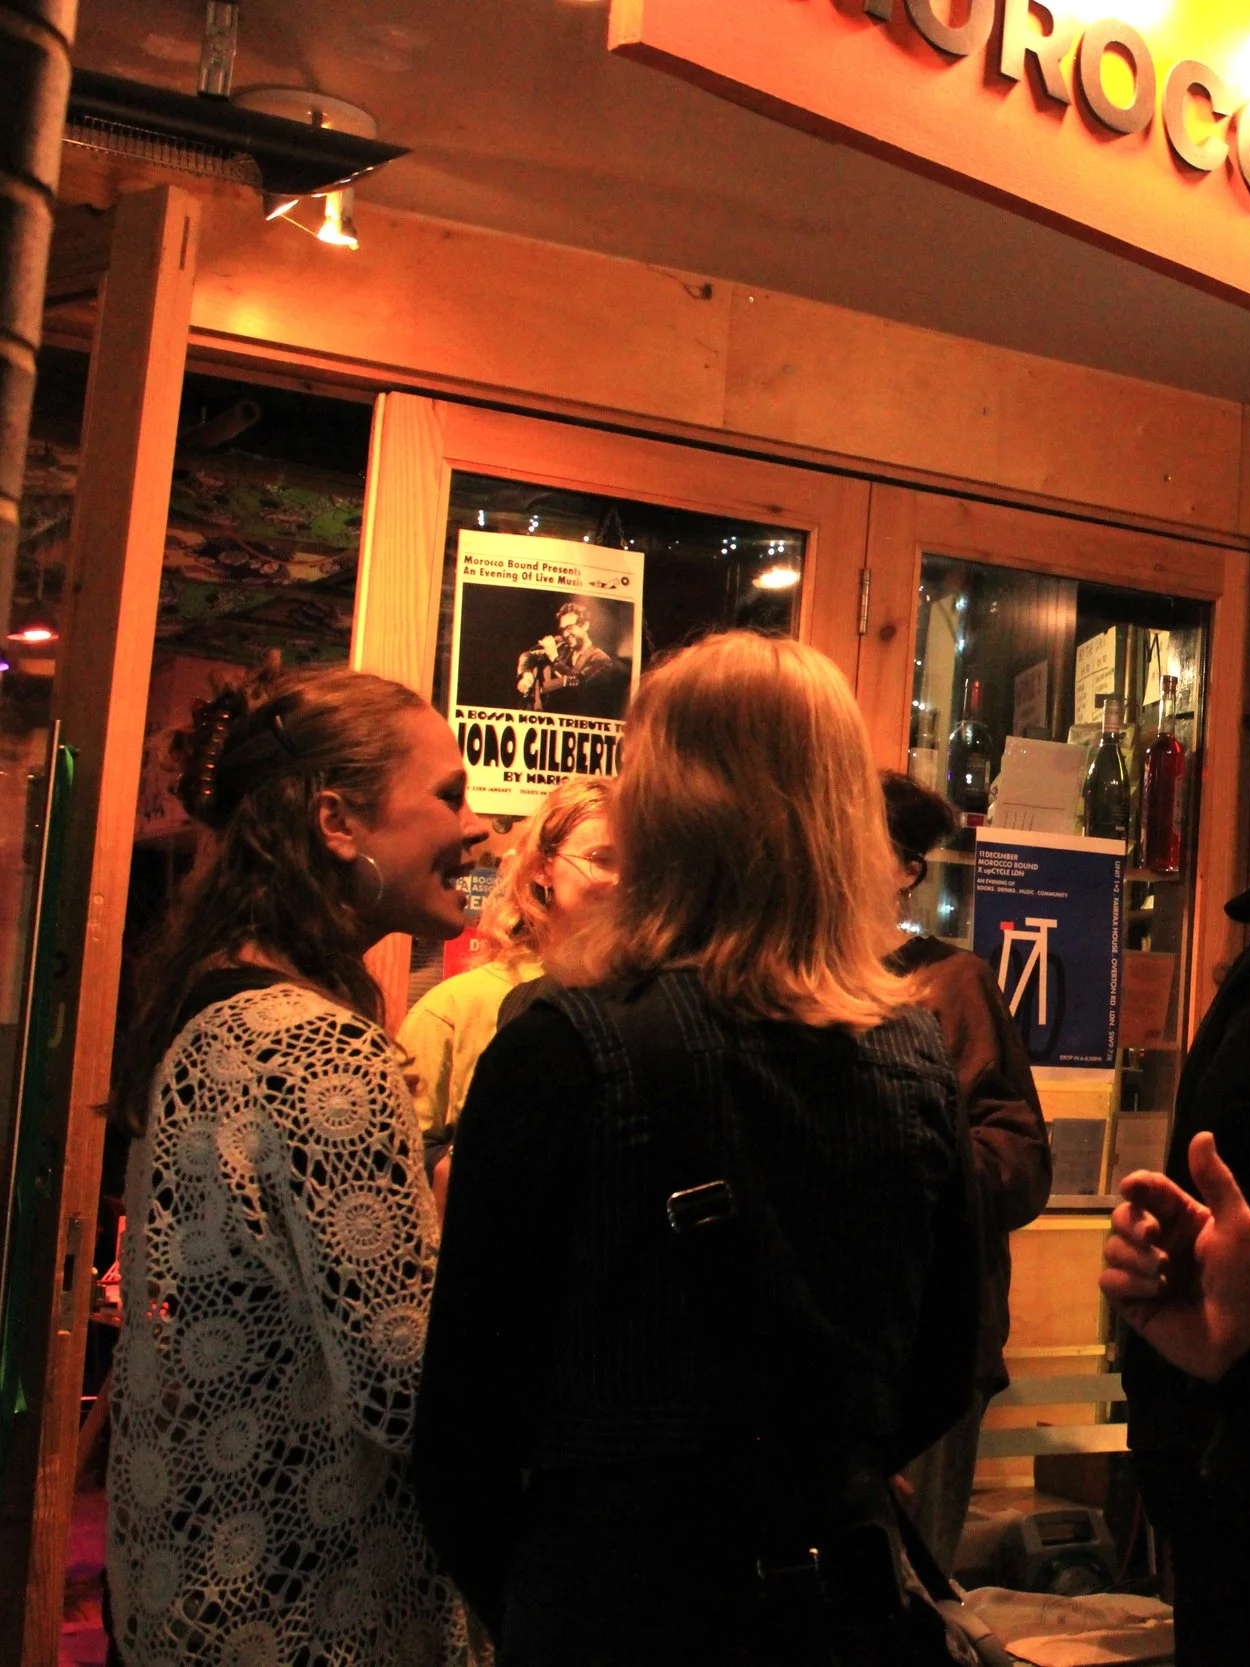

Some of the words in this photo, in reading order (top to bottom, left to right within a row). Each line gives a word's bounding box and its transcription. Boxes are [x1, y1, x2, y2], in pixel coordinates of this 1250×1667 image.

[463, 555, 504, 568] Morocco
[507, 559, 539, 571] Bound
[542, 562, 581, 576] Presents
[463, 566, 476, 576] An
[479, 568, 518, 582] Evening
[521, 571, 532, 581] Of
[535, 573, 554, 584] Live
[557, 576, 583, 587] Music
[455, 709, 465, 719] A
[467, 710, 514, 723] BOSSA
[518, 714, 555, 727] NOVA
[558, 717, 611, 732] TRIBUTE
[503, 771, 523, 782] BY
[978, 859, 1012, 868] MOROCCO
[1013, 862, 1039, 871] BOUND
[985, 851, 1019, 861] DECEMBER
[1112, 896, 1120, 927] FAIRFAX
[1111, 927, 1119, 954] HOUSE
[1110, 958, 1118, 994] OVERTON
[1109, 995, 1117, 1006] RD
[1108, 1010, 1116, 1026] LDN
